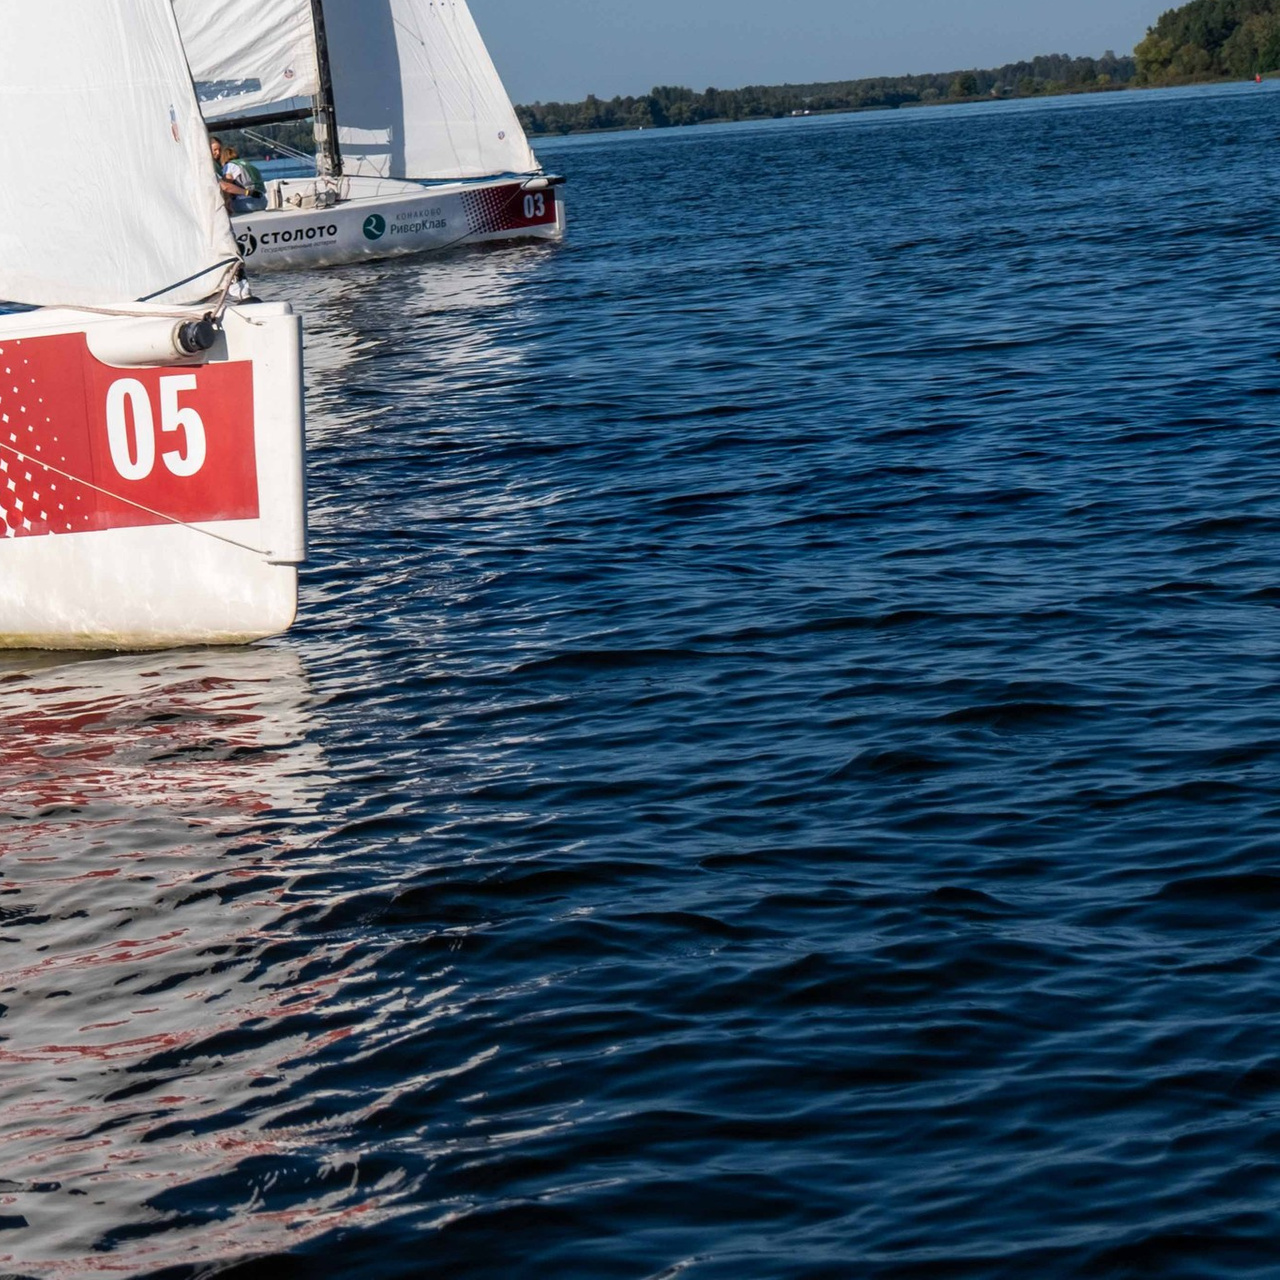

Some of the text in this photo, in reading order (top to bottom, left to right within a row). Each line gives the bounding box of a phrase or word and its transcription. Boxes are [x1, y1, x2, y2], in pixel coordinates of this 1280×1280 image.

[523, 193, 545, 218] 03
[260, 224, 338, 245] СТОЛОТО
[390, 218, 447, 235] РиверКлаб
[106, 374, 207, 481] 05
